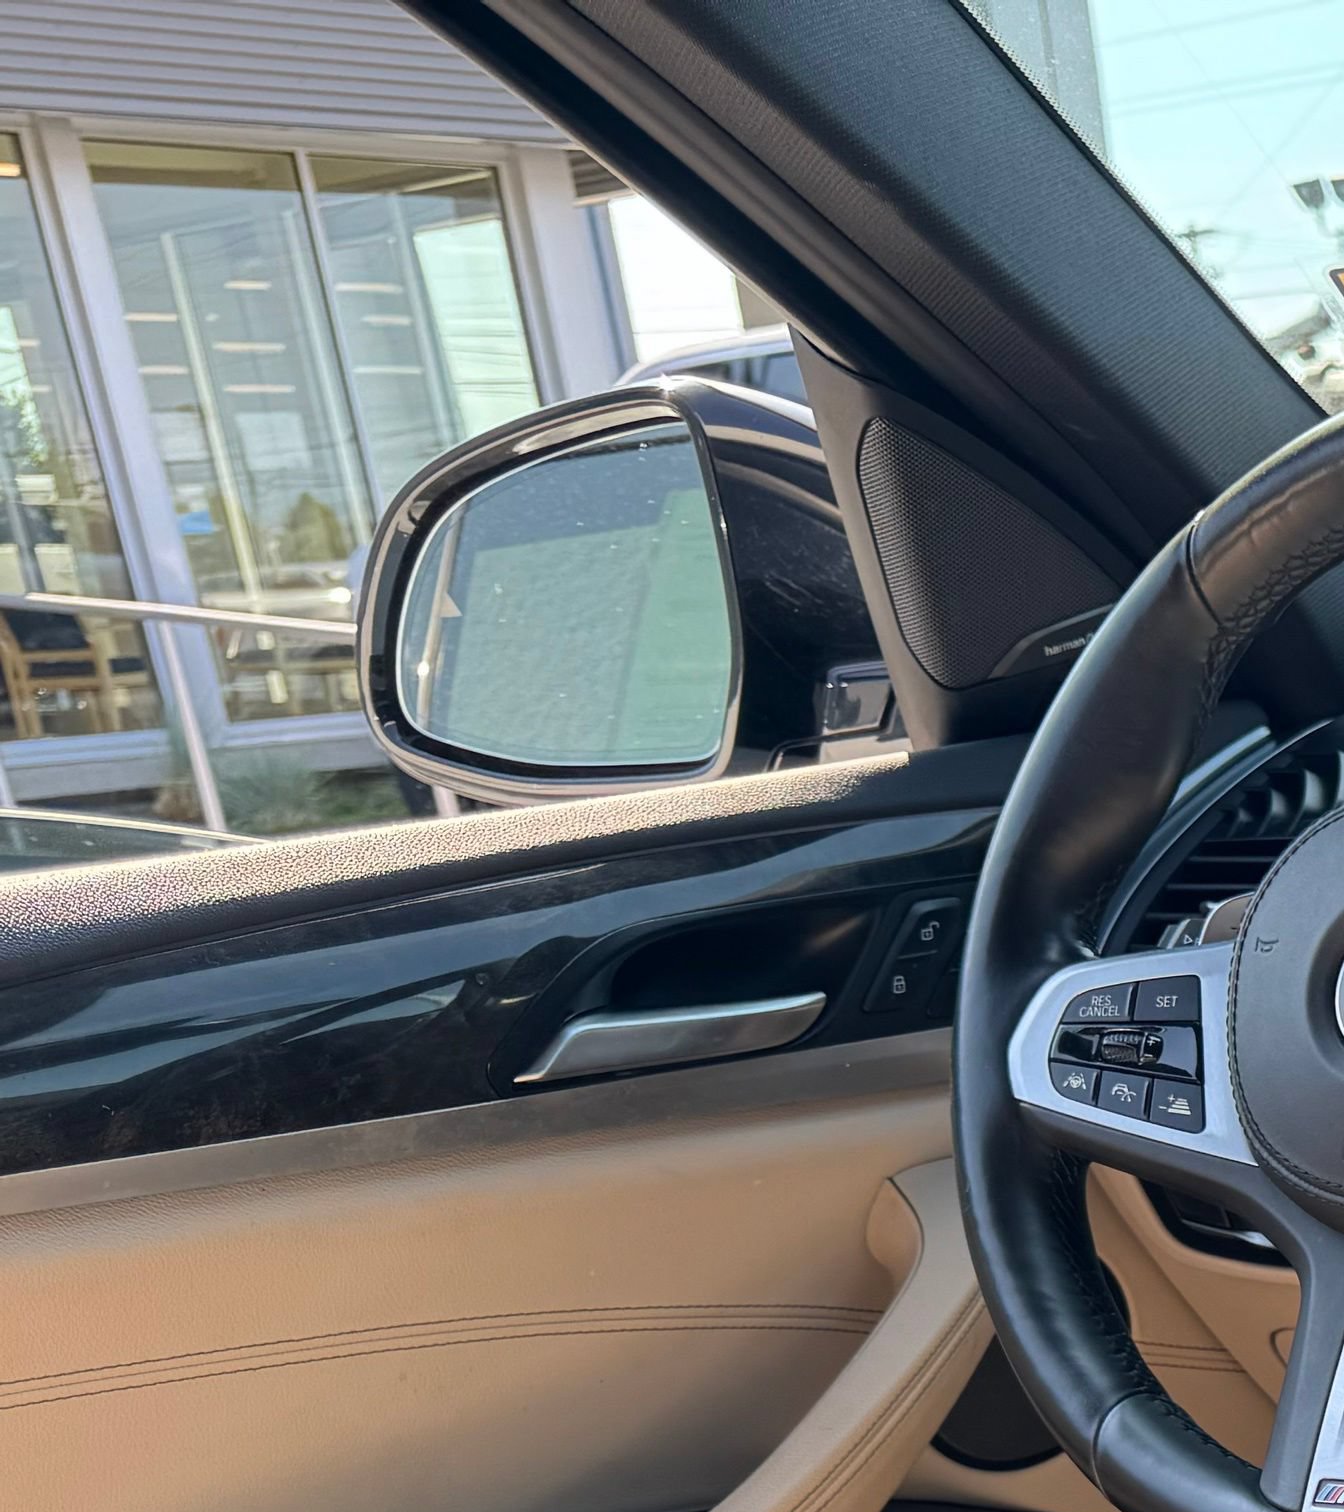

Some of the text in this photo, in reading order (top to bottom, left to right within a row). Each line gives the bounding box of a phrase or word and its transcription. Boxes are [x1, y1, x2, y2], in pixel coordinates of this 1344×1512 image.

[1043, 637, 1086, 657] harman
[1091, 995, 1112, 1006] RES
[1156, 995, 1179, 1008] SET
[1079, 1006, 1120, 1018] CANCEL
